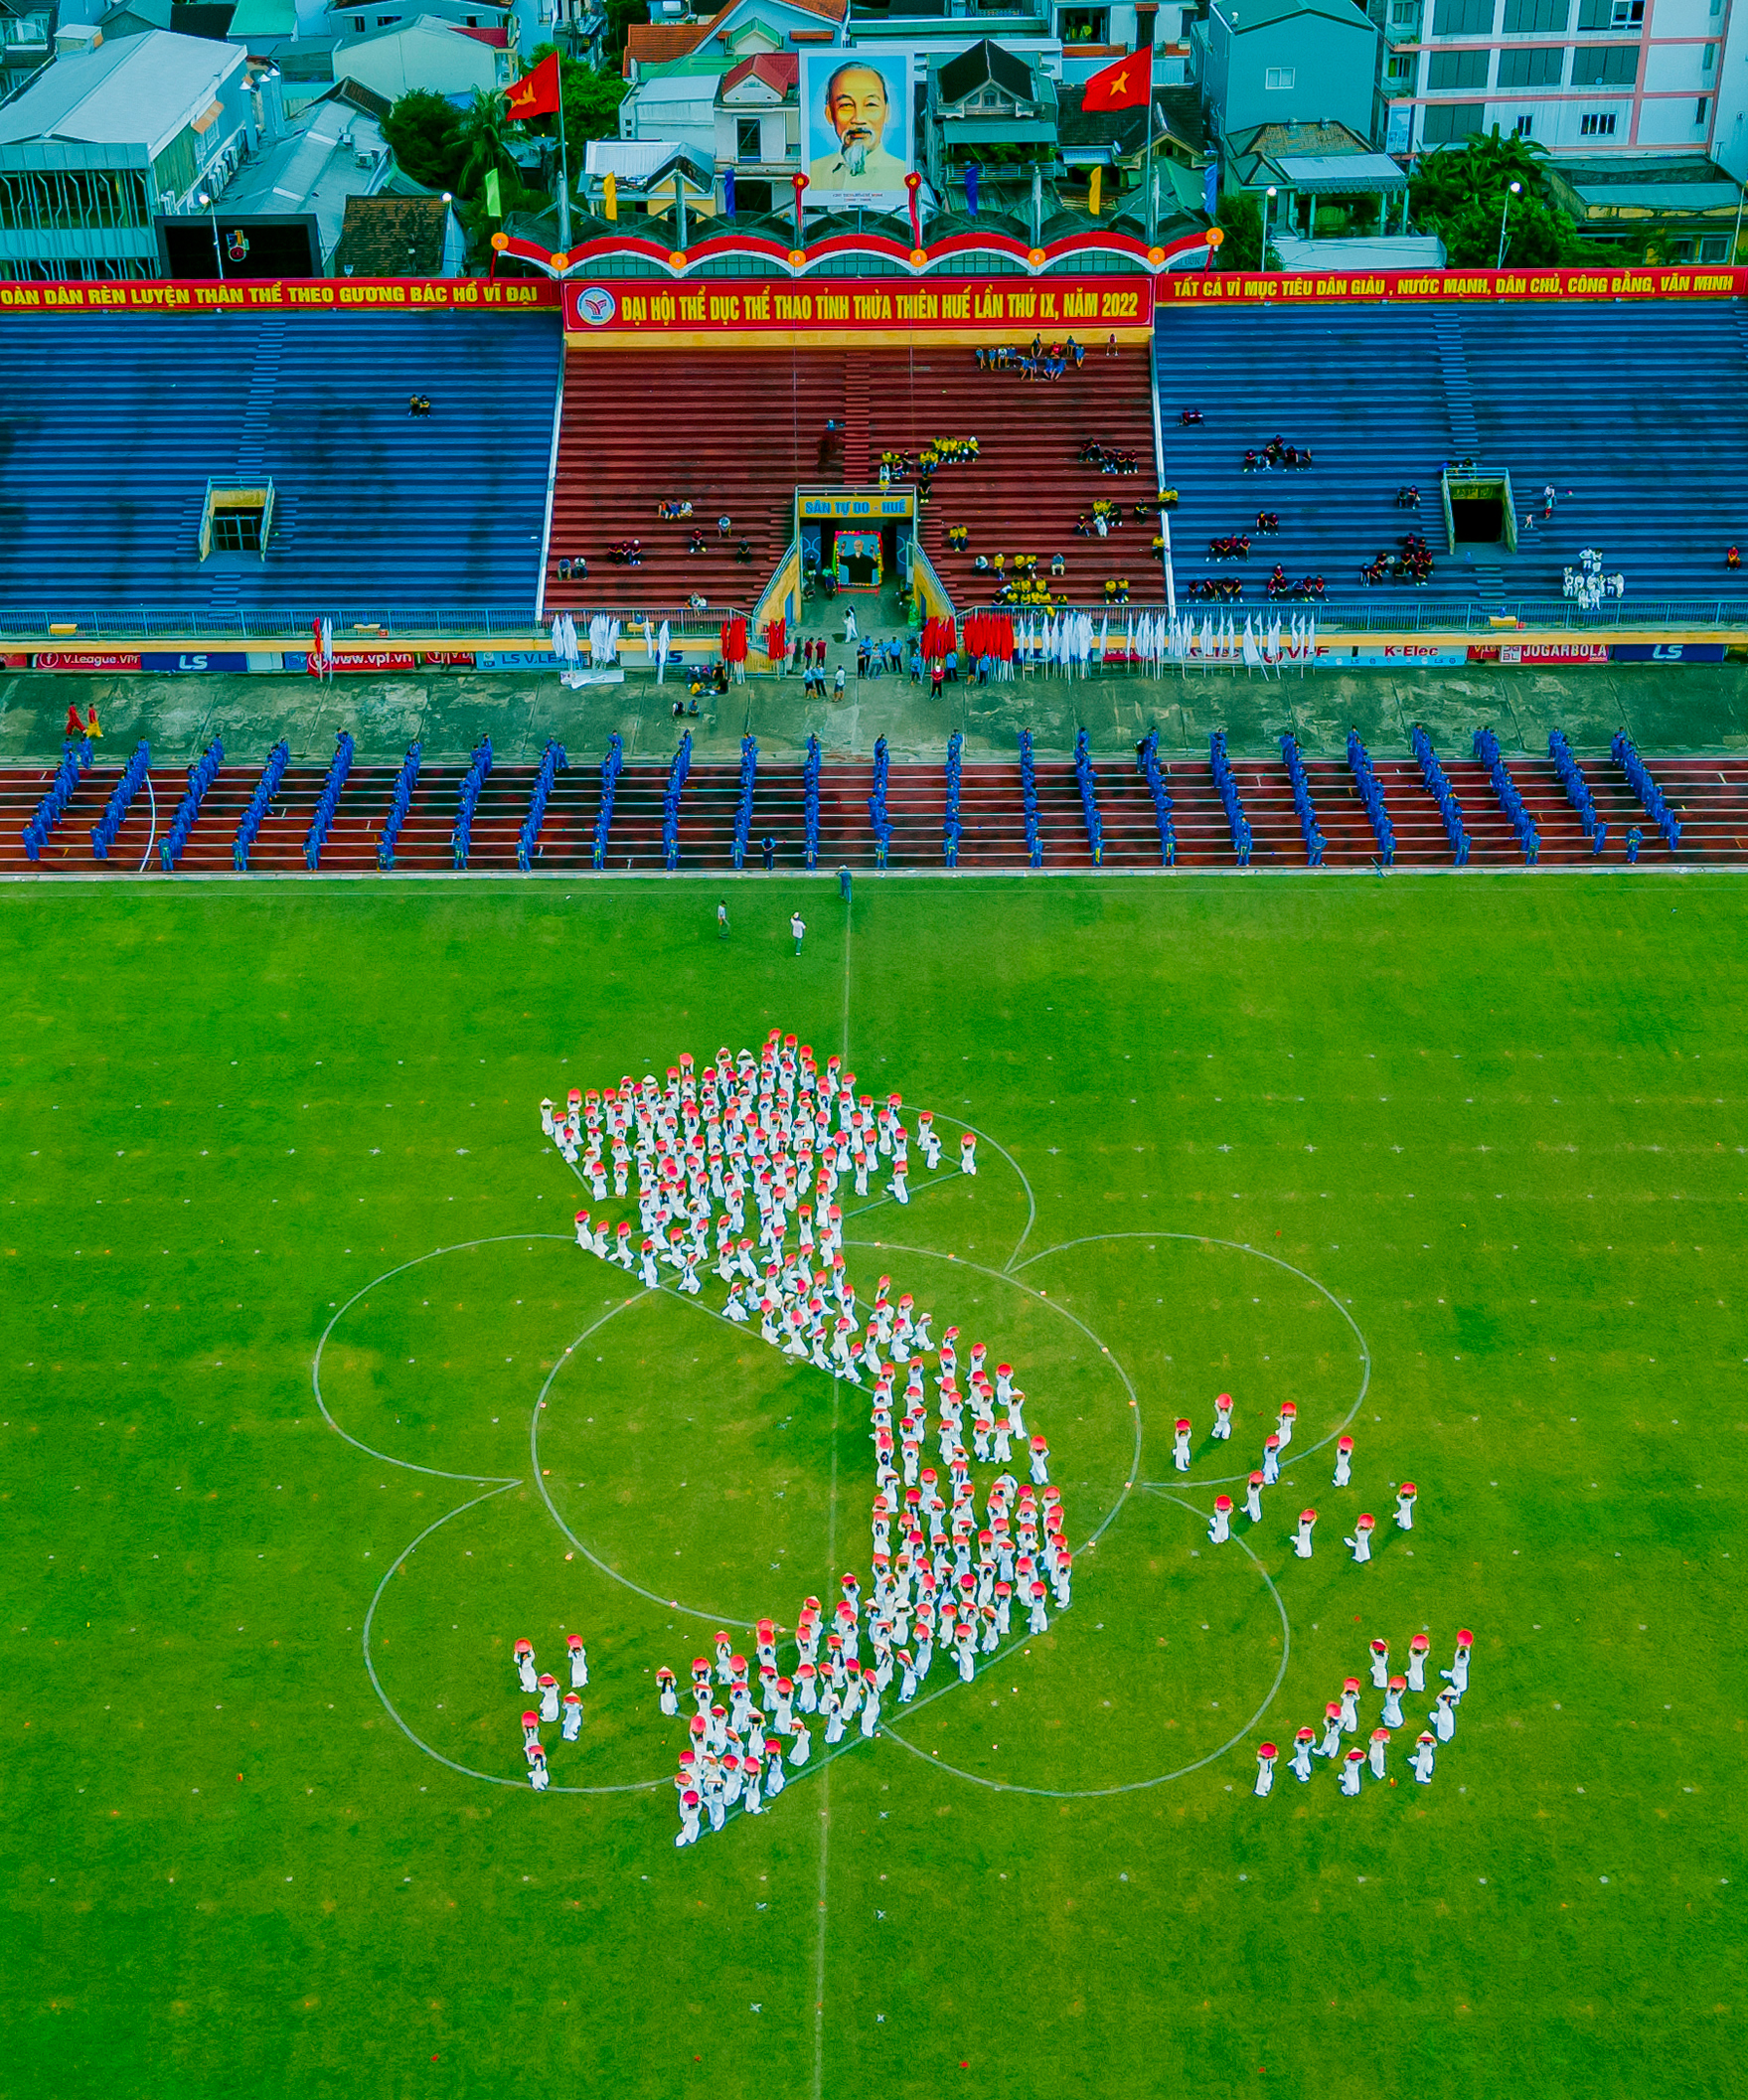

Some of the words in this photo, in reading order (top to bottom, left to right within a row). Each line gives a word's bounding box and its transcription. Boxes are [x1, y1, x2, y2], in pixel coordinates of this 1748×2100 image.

[1175, 274, 1200, 297] TẤT
[1202, 275, 1222, 297] CẢ
[1226, 275, 1241, 297] VÌ
[1243, 278, 1277, 300] MỤC
[1281, 274, 1315, 296] TIÊU
[1317, 274, 1348, 296] DÂN
[1351, 273, 1386, 296] GIÀU
[1397, 272, 1440, 295] NƯỚC
[1443, 277, 1493, 298] MẠNH,
[1495, 273, 1527, 295] DÂN
[1530, 272, 1565, 297] CHỦ,
[1567, 273, 1609, 294] CÔNG
[1611, 269, 1657, 295] BẰNG,
[1661, 271, 1690, 293] VĂN
[1692, 274, 1734, 292] MINH
[43, 284, 84, 305] DÂN
[87, 284, 127, 305] RÈN
[130, 284, 191, 307] LUYỆN
[194, 284, 244, 304] THÂN
[247, 280, 283, 304] THỂ
[286, 286, 336, 304] THEO
[339, 284, 406, 304] GƯƠNG
[409, 282, 448, 304] BÁC
[452, 280, 480, 303] HỒ
[482, 282, 502, 303] VĨ
[505, 285, 538, 306] ĐẠI
[621, 295, 648, 327] ĐẠI
[650, 289, 676, 327] HỘI
[678, 284, 707, 321] THỂ
[710, 295, 740, 325] DỤC
[742, 284, 771, 321] THỂ
[773, 294, 812, 320] THAO
[815, 287, 850, 320] TỈNH
[853, 288, 892, 320] THỪA
[894, 287, 938, 320] THIÊN
[941, 284, 972, 320] HUẾ
[974, 283, 1004, 320] LẦN
[1007, 286, 1037, 319] THỨ
[1039, 293, 1060, 322] IX,
[1062, 286, 1099, 319] NĂM
[1101, 292, 1139, 318] 2022
[805, 499, 831, 514] SÂN
[834, 501, 852, 517] TỰ
[853, 501, 871, 515] DO
[880, 498, 906, 514] HUẾ
[1384, 646, 1439, 656] K-Elec
[1522, 644, 1607, 657] JOGARBOLA
[1653, 644, 1683, 659] LS
[179, 655, 208, 670] LS
[501, 654, 521, 664] LS
